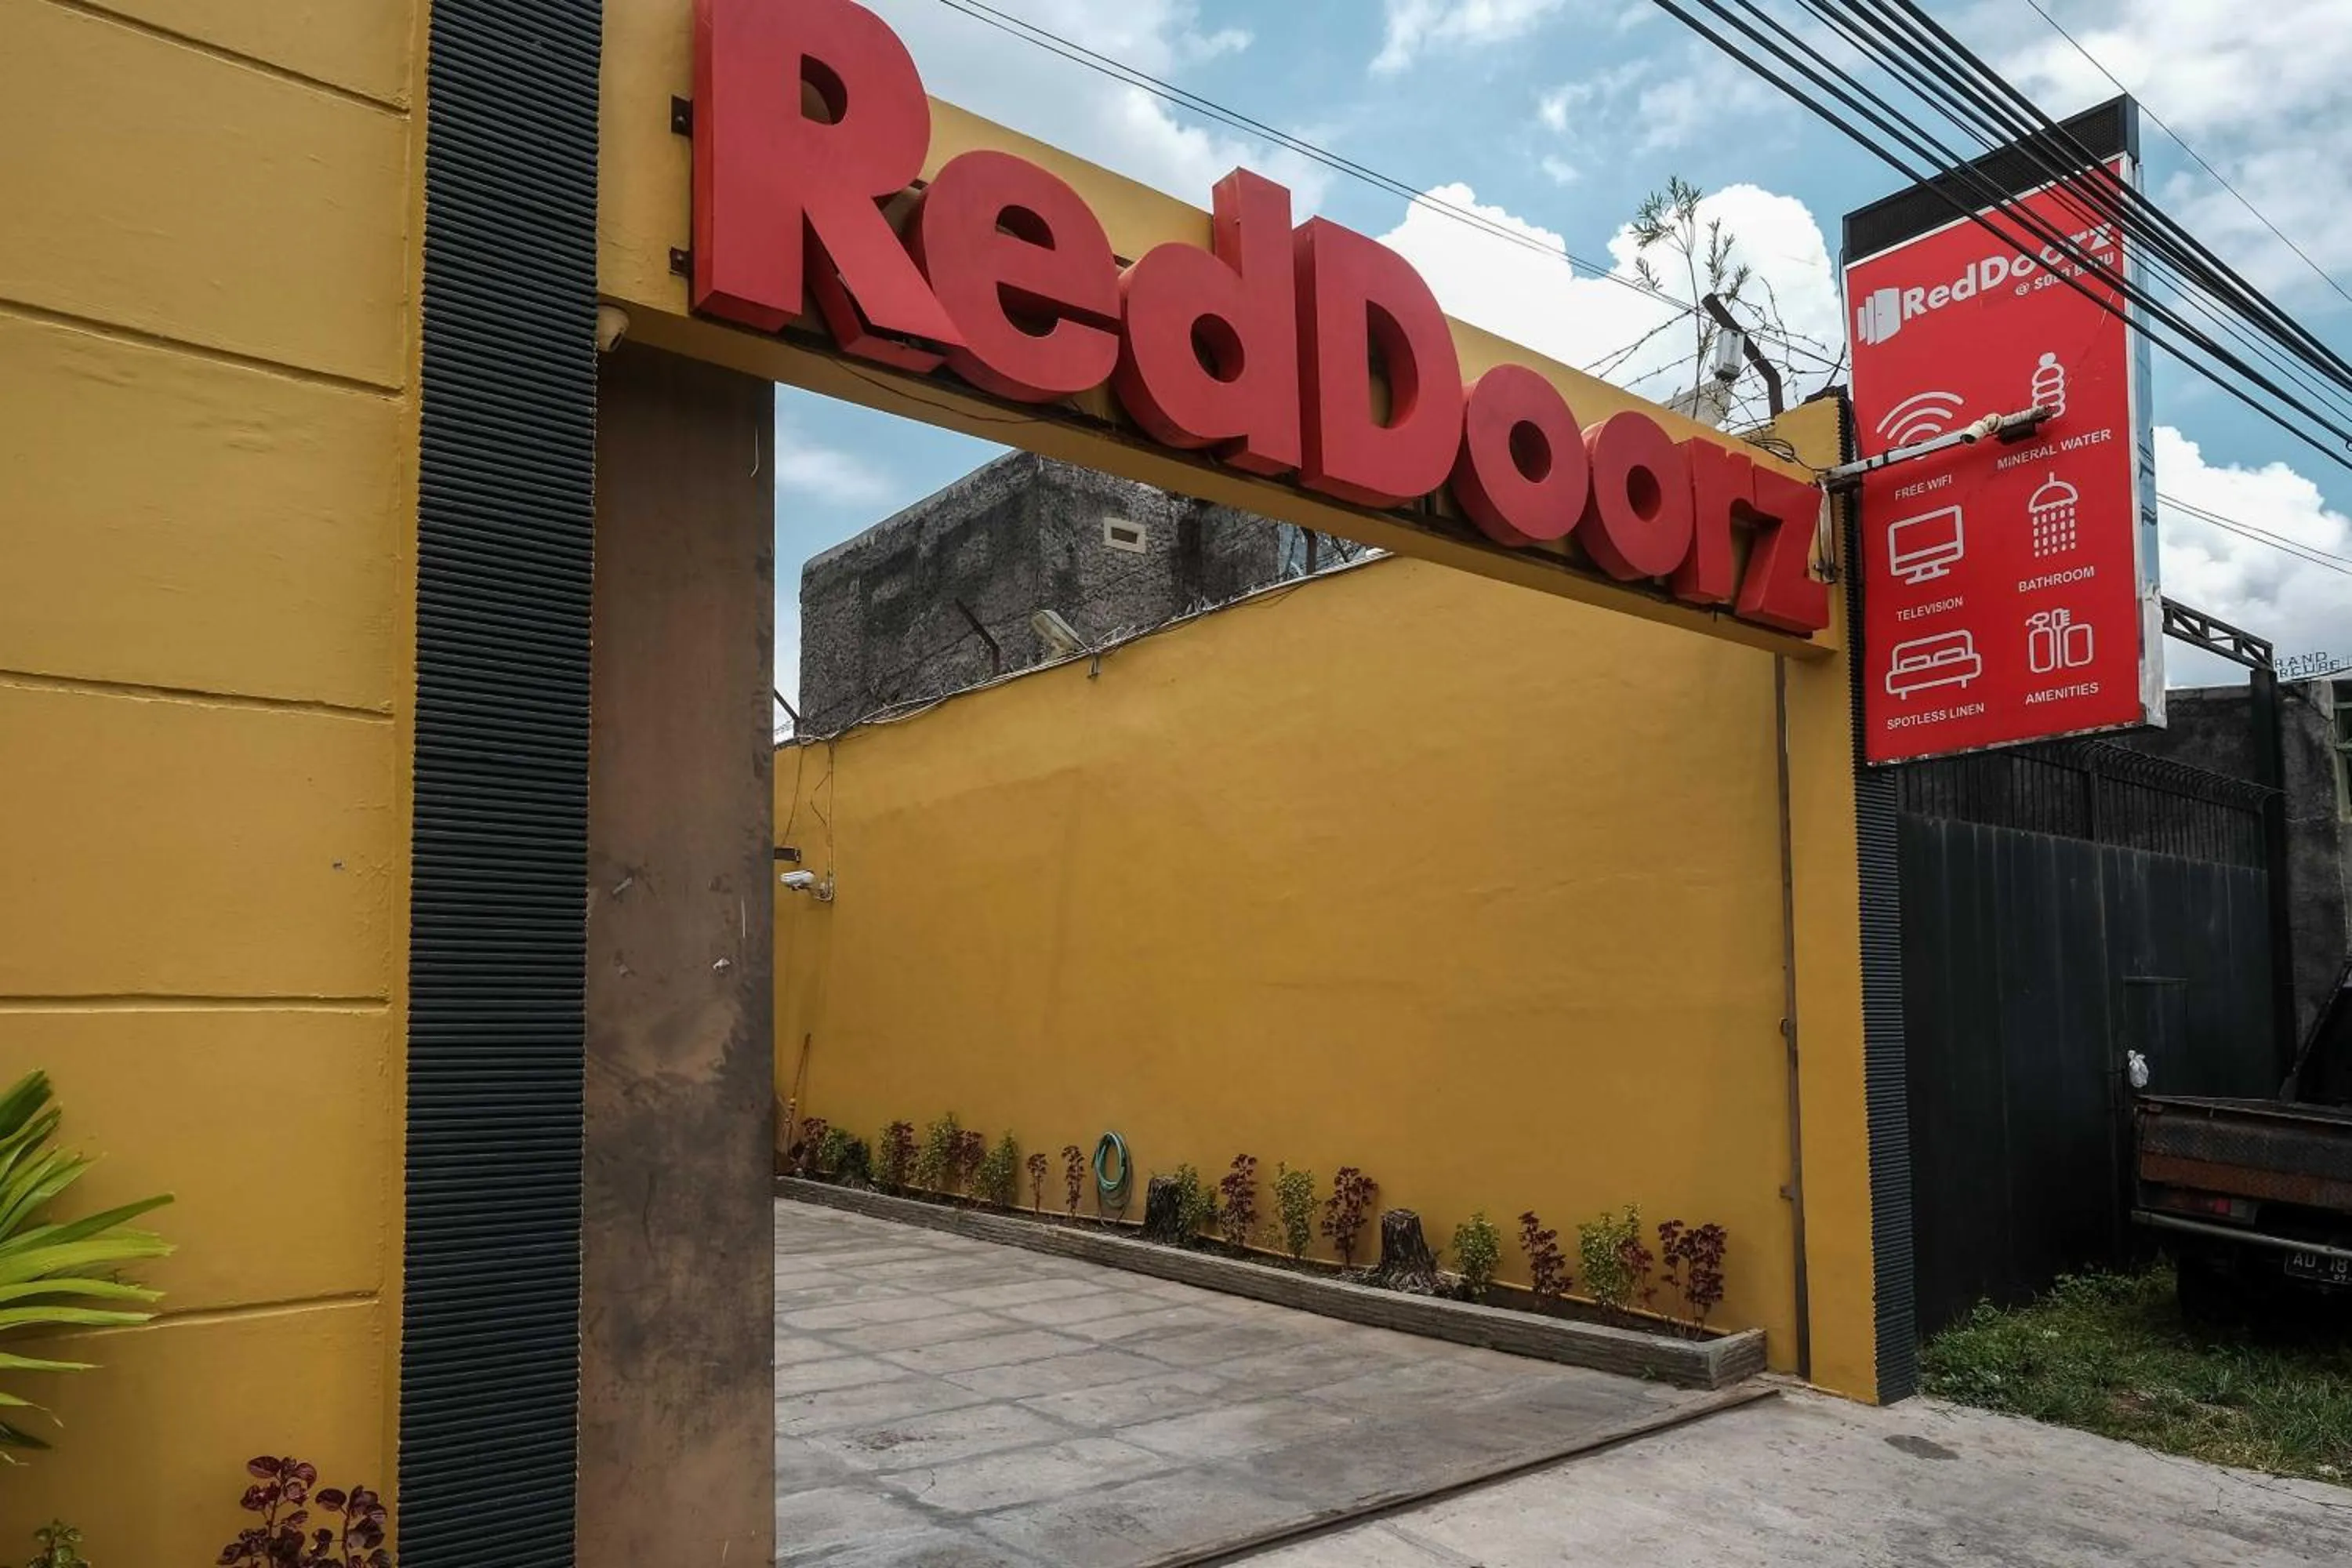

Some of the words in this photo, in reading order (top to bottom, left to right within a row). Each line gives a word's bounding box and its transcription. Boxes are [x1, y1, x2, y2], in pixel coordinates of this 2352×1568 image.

[2015, 281, 2031, 296] @
[691, 0, 1830, 632] RedDoorz
[1996, 445, 2057, 470] MINERAL
[2060, 428, 2111, 452] WATER
[1894, 482, 1926, 499] FREE
[1926, 474, 1952, 492] WIFI
[2018, 565, 2095, 593] BATHROOM
[1896, 596, 1964, 622] TELEVISION
[2025, 681, 2100, 705] AMENITIES
[1886, 709, 1947, 731] SPOTLESS
[1949, 702, 1985, 719] LINEN
